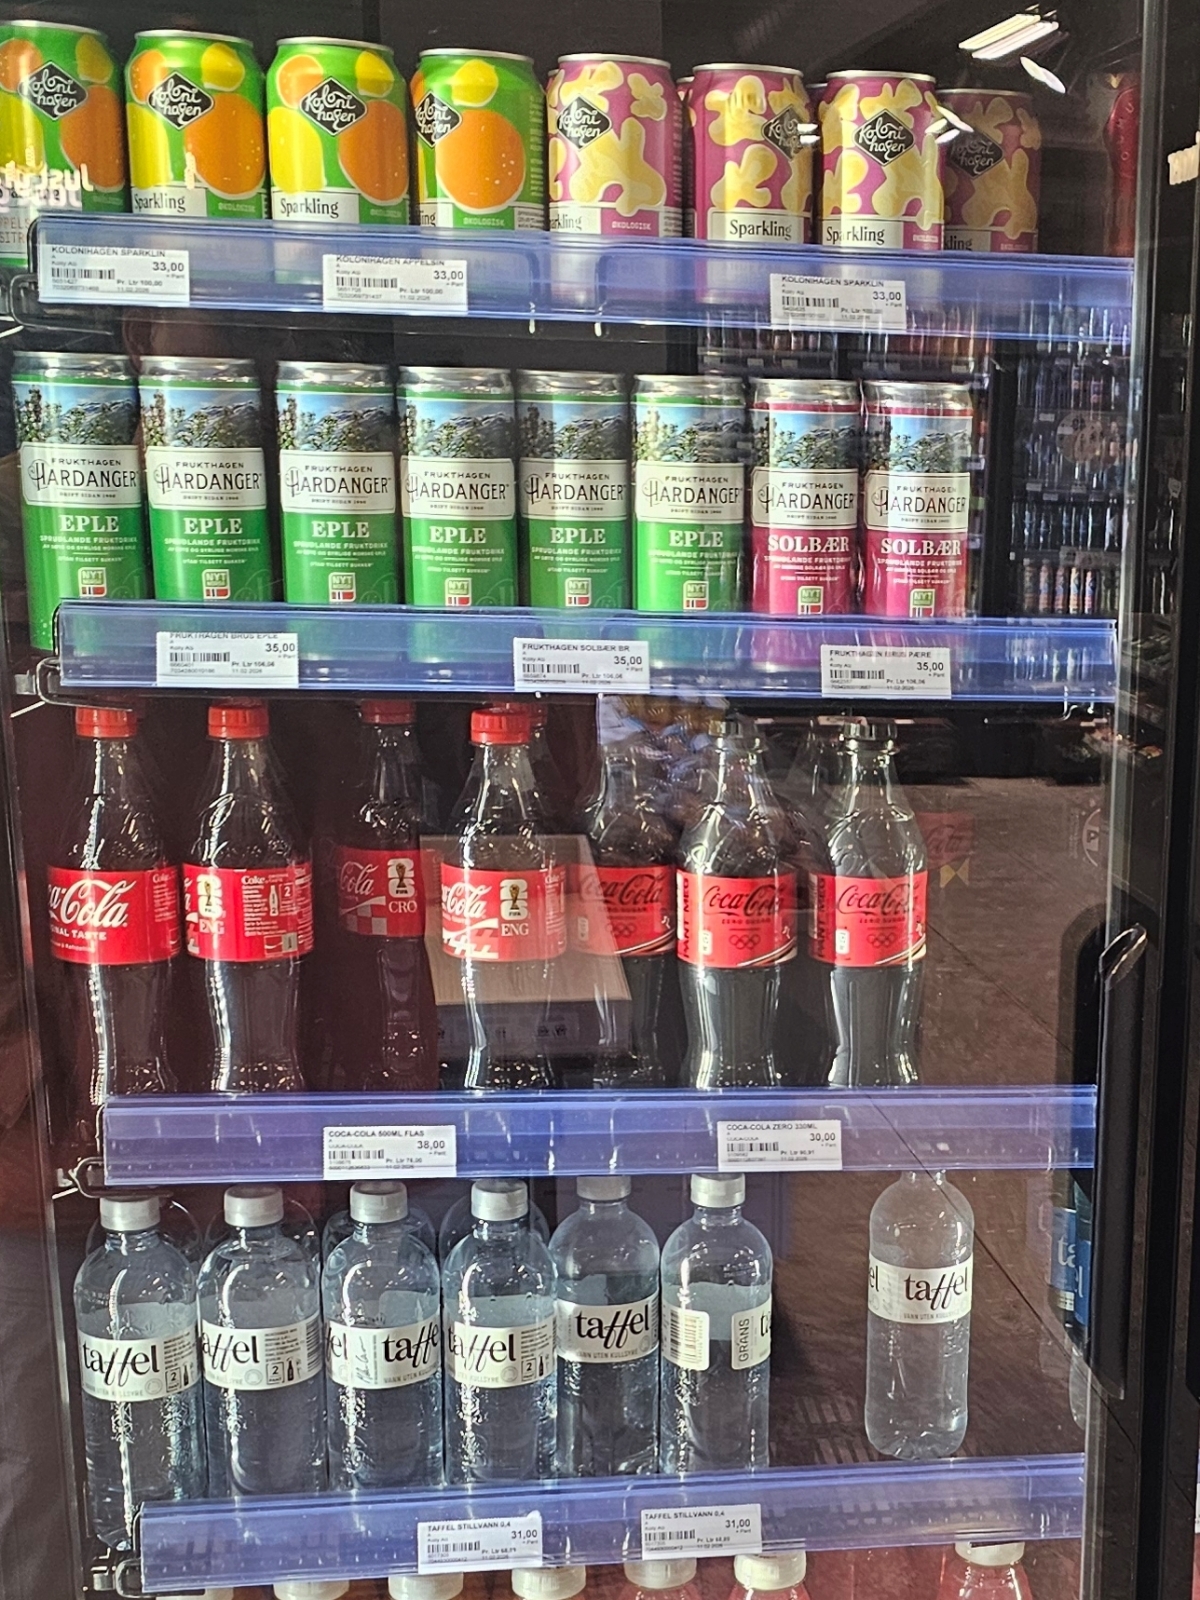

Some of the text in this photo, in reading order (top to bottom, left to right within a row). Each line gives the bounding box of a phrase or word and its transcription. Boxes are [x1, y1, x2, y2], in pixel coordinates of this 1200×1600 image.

[163, 101, 201, 125] hagen
[416, 95, 451, 121] oloni
[319, 106, 357, 132] hagen
[567, 124, 601, 149] hagen
[869, 138, 907, 161] hagen
[133, 192, 186, 213] Sparkling
[279, 198, 339, 220] Sparkling
[729, 220, 792, 241] Sparkling
[826, 226, 885, 246] Sparkling
[52, 247, 165, 257] KOLONIHAGEN SPARKLIN
[152, 262, 184, 273] 33,00
[433, 270, 464, 281] 33,00
[782, 276, 884, 288] KOLONIHAGEN SPARKLIN
[872, 291, 901, 302] 33,00
[51, 457, 121, 466] FRUKTHAGEN
[176, 461, 244, 469] FRUKTHAGEN
[28, 459, 137, 491] HARDANGER
[154, 464, 261, 495] HARDANGER
[285, 467, 390, 498] HARDANGER
[424, 471, 490, 479] FRUKTHAGEN
[665, 476, 728, 484] FRUKTHAGEN
[405, 473, 506, 503] HARDANGER
[525, 474, 624, 505] HARDANGER
[897, 485, 956, 493] FRUKTHAGEN
[758, 484, 854, 513] HARDANGER
[59, 514, 120, 532] EPLE
[183, 518, 243, 535] EPLE
[311, 521, 370, 538] EPLE
[429, 526, 486, 544] EPLE
[550, 527, 606, 544] EPLE
[669, 531, 723, 547] EPLE
[768, 534, 849, 553] SOLBÆR
[881, 537, 961, 556] SOLBÆR
[265, 643, 295, 654] 35,00
[522, 643, 578, 651] FRUKTHAGEN
[613, 656, 642, 667] 35,00
[916, 662, 944, 673] 35,00
[340, 861, 379, 896] Cola
[60, 879, 136, 928] Cola
[388, 900, 418, 913] CRO
[71, 930, 107, 941] TASTE
[501, 923, 529, 937] ENG
[417, 1140, 445, 1151] 38,00
[809, 1132, 836, 1143] 30,00
[904, 1266, 968, 1310] taffel
[575, 1304, 650, 1349] taffel
[448, 1327, 517, 1373] taffel
[82, 1341, 160, 1387] taffel
[272, 1366, 279, 1375] 2
[526, 1362, 532, 1371] 2
[170, 1372, 177, 1381] 2
[674, 1511, 713, 1519] STILLVANN
[458, 1522, 499, 1530] STILLVANN
[725, 1519, 750, 1529] 31,00
[511, 1529, 538, 1539] 31,00
